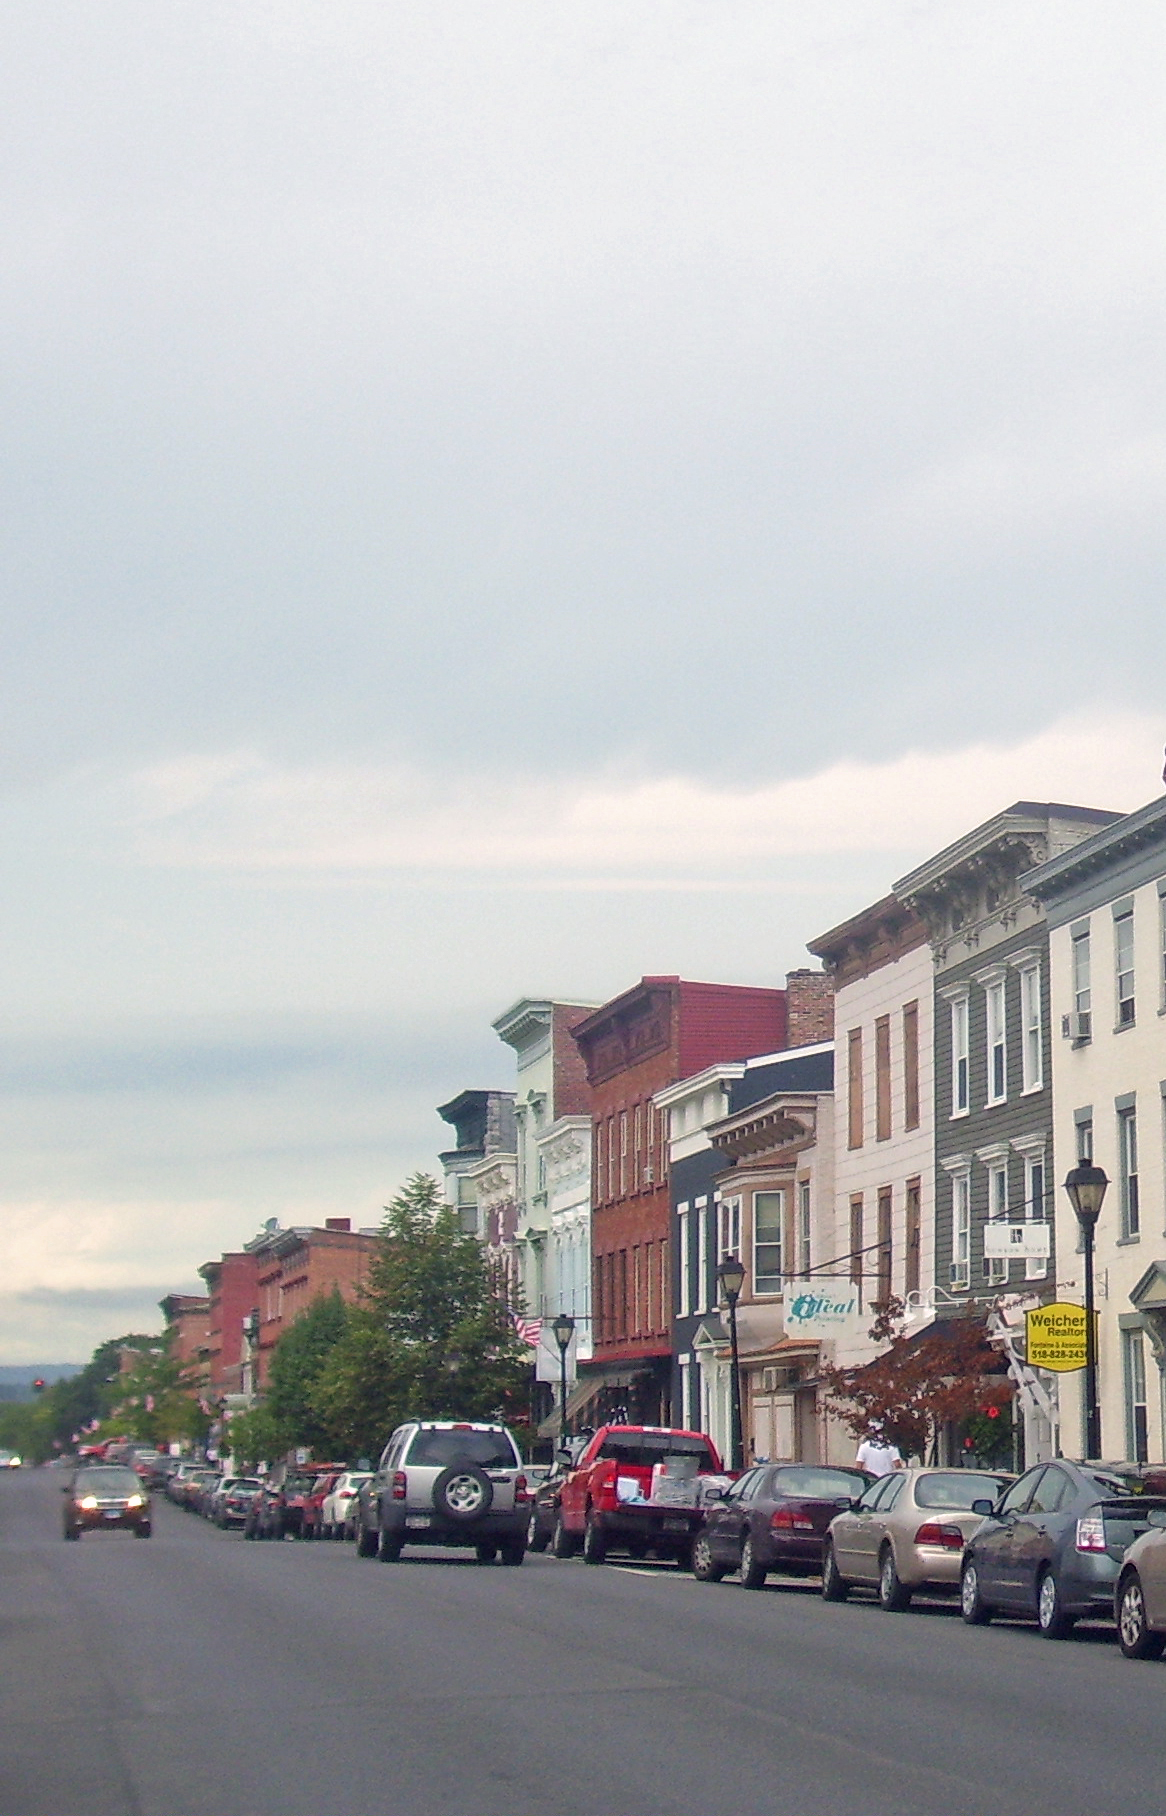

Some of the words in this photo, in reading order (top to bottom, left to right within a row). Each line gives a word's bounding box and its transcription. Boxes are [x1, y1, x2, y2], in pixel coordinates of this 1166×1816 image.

[1030, 1314, 1085, 1327] Weicher
[1047, 1327, 1086, 1336] Realtor
[1032, 1350, 1087, 1359] 518-828-243
